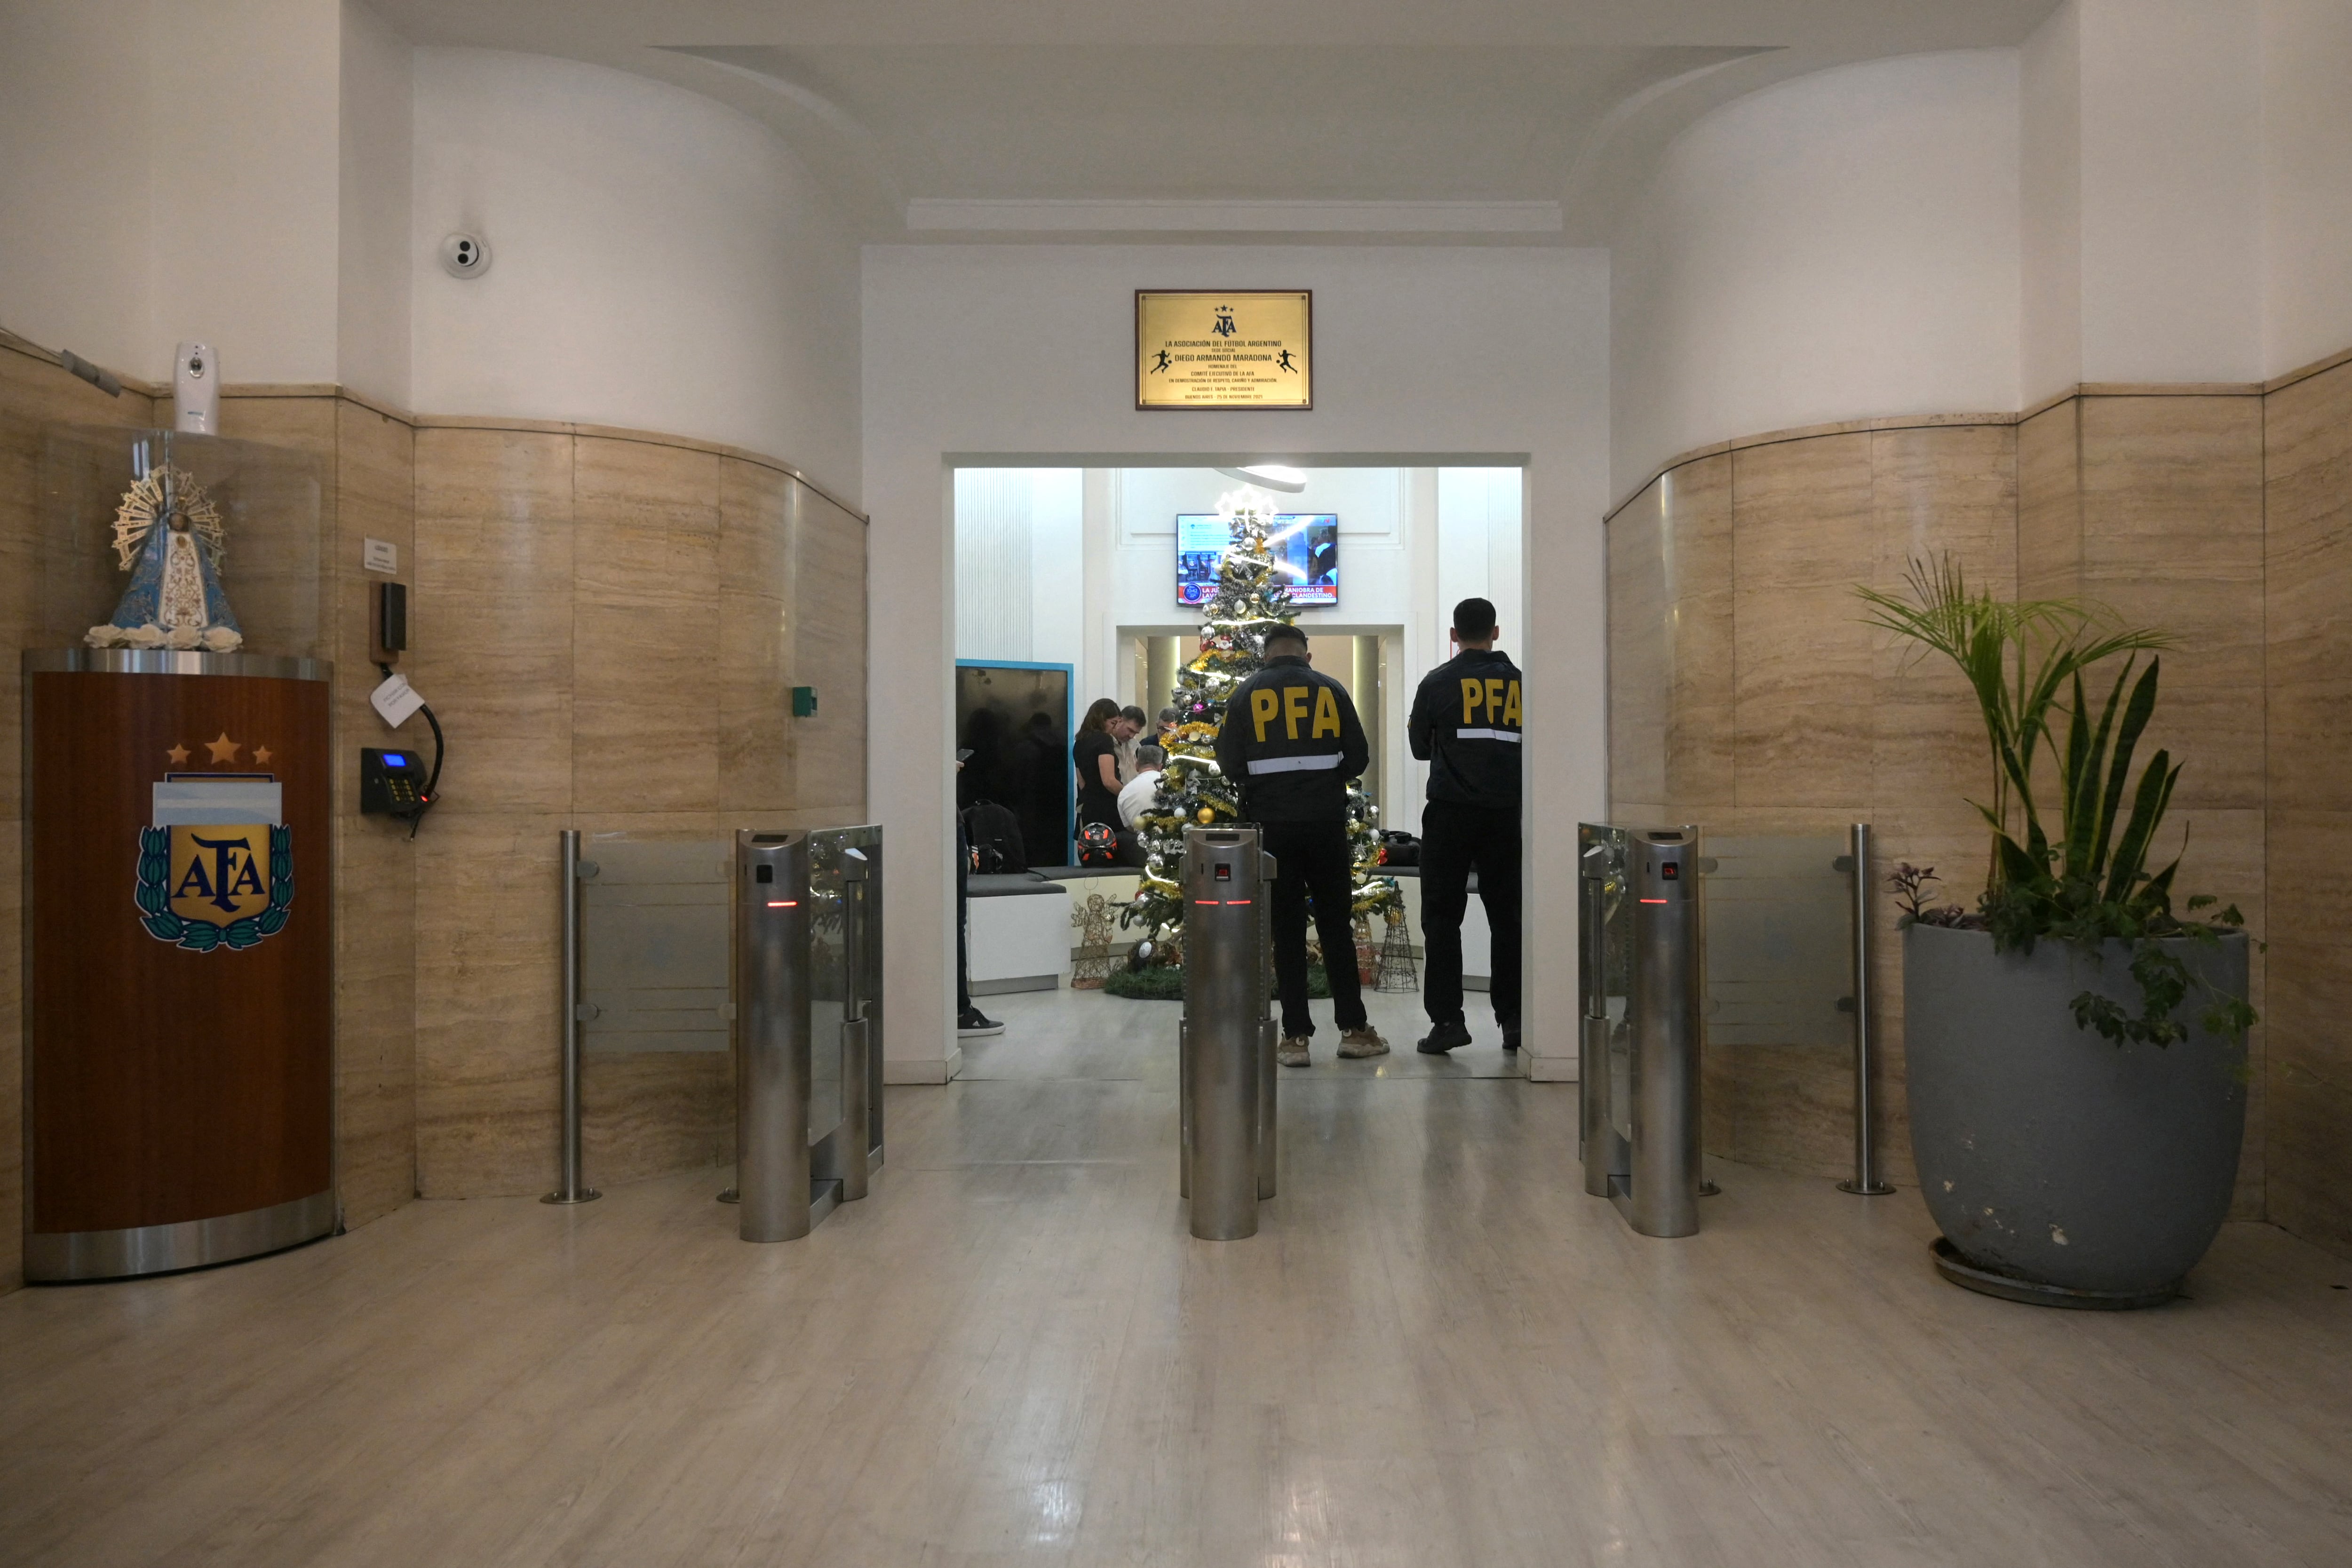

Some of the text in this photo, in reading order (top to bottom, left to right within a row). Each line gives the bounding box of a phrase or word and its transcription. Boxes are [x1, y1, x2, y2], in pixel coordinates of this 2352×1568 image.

[1211, 314, 1237, 337] AFA
[1250, 686, 1340, 742] PFA
[1459, 678, 1522, 726] PFA
[171, 833, 265, 913] AFA
